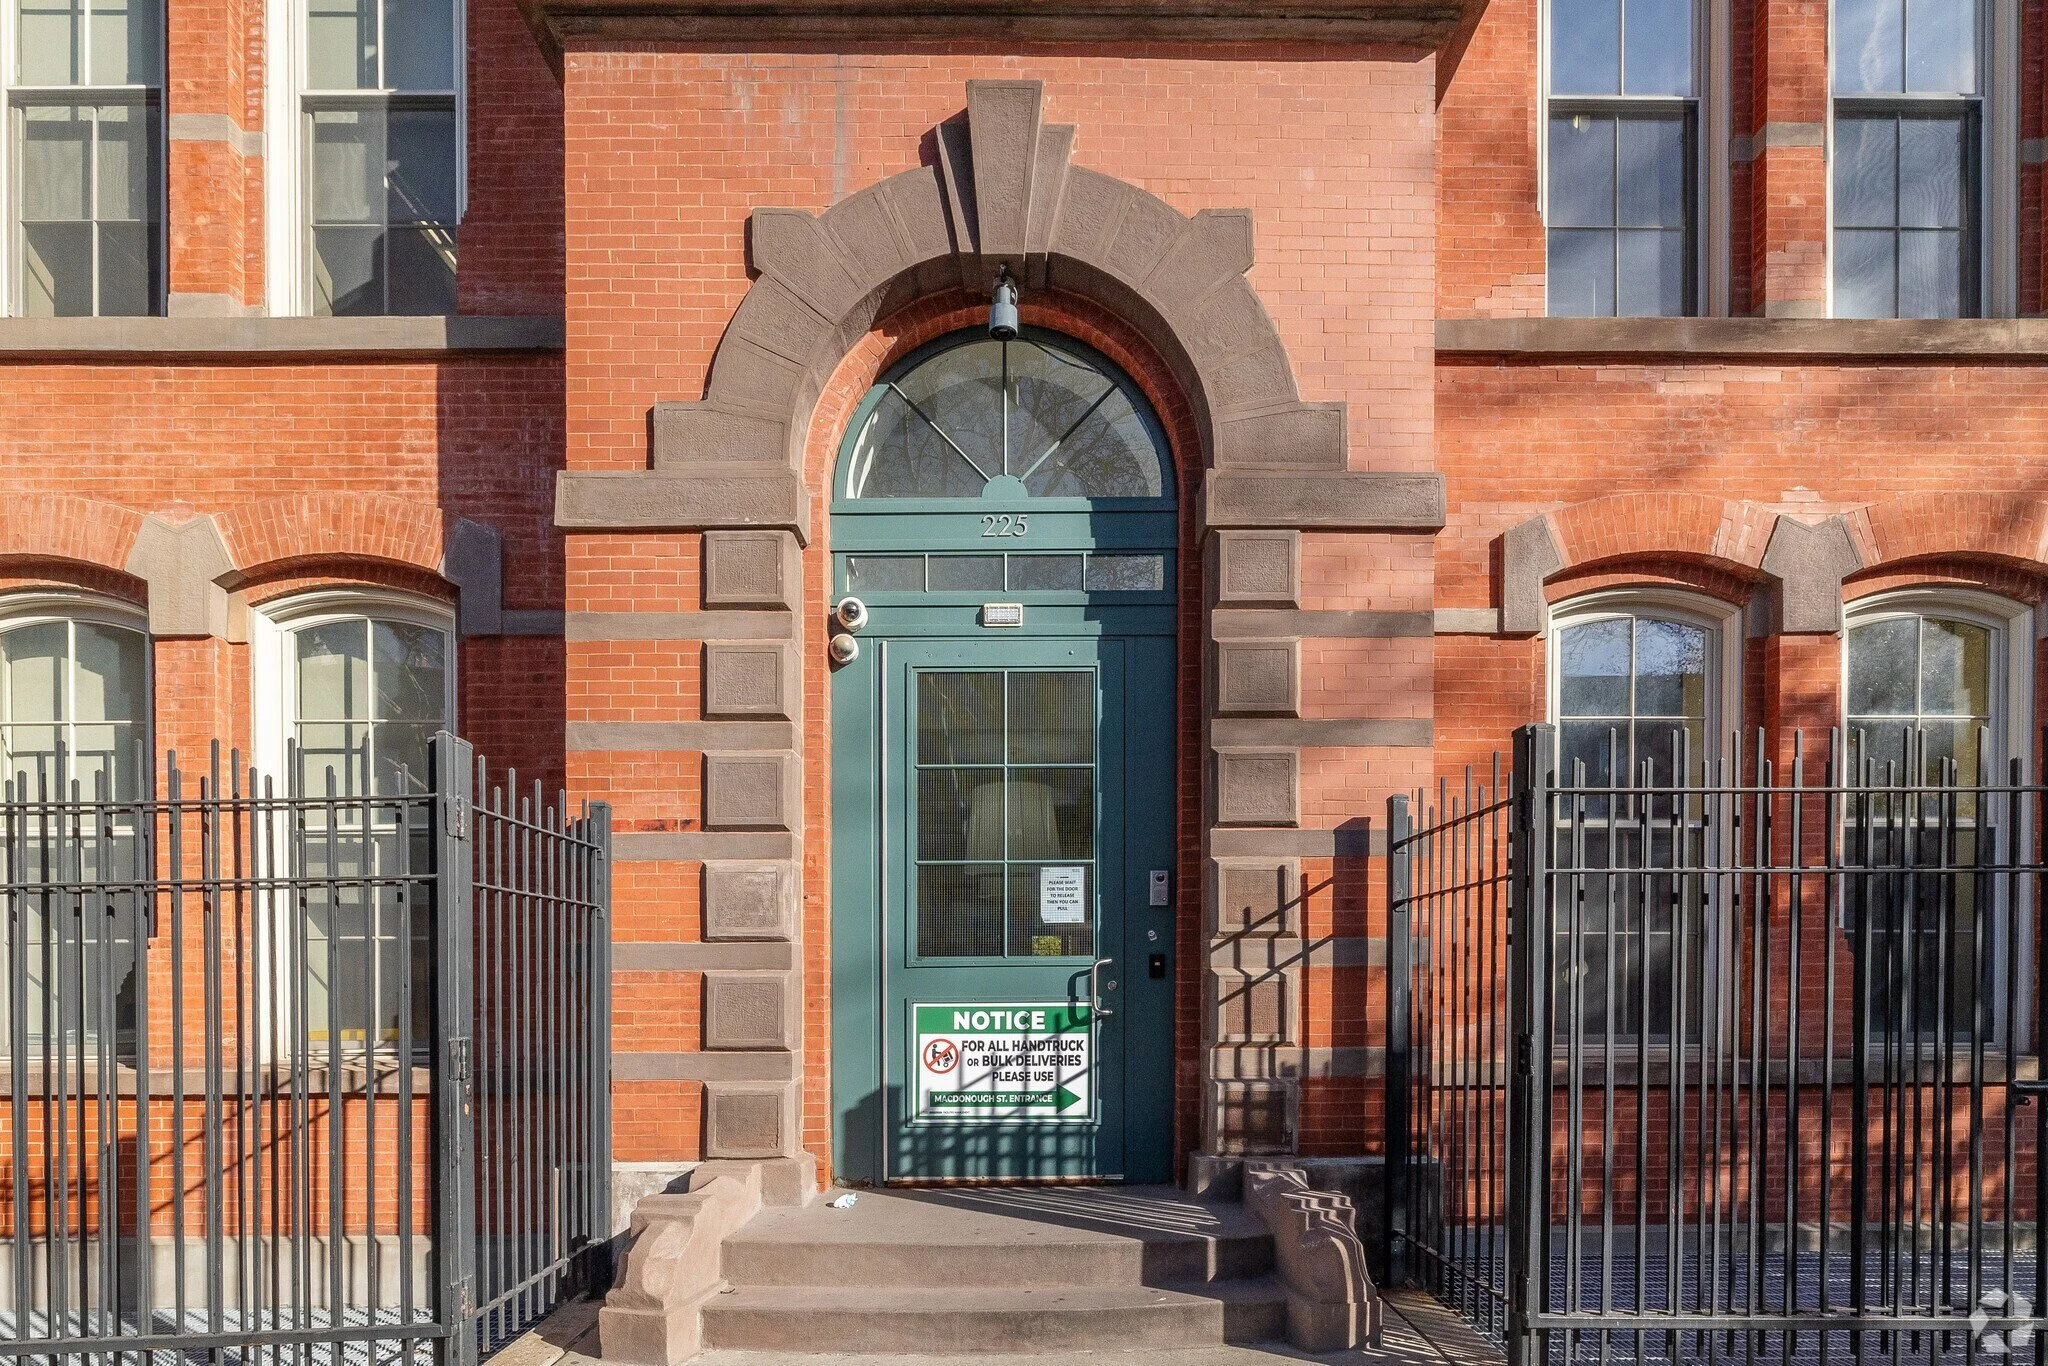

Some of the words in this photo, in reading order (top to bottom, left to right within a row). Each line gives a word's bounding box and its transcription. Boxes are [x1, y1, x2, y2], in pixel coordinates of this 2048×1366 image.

[981, 514, 1027, 537] 225
[953, 1010, 1046, 1030] NOTICE
[961, 1040, 985, 1051] FOR
[988, 1040, 1009, 1051] ALL
[1012, 1040, 1084, 1051] HANDTRUCK
[967, 1058, 979, 1066] OR
[982, 1055, 1014, 1066] BULK
[1016, 1055, 1082, 1066] DELIVERIES
[992, 1072, 1031, 1081] PLEASE
[1034, 1072, 1054, 1081] USE
[934, 1094, 994, 1102] MACDONOUGH
[996, 1094, 1008, 1102] ST.
[1009, 1094, 1053, 1102] ENTRANCE
